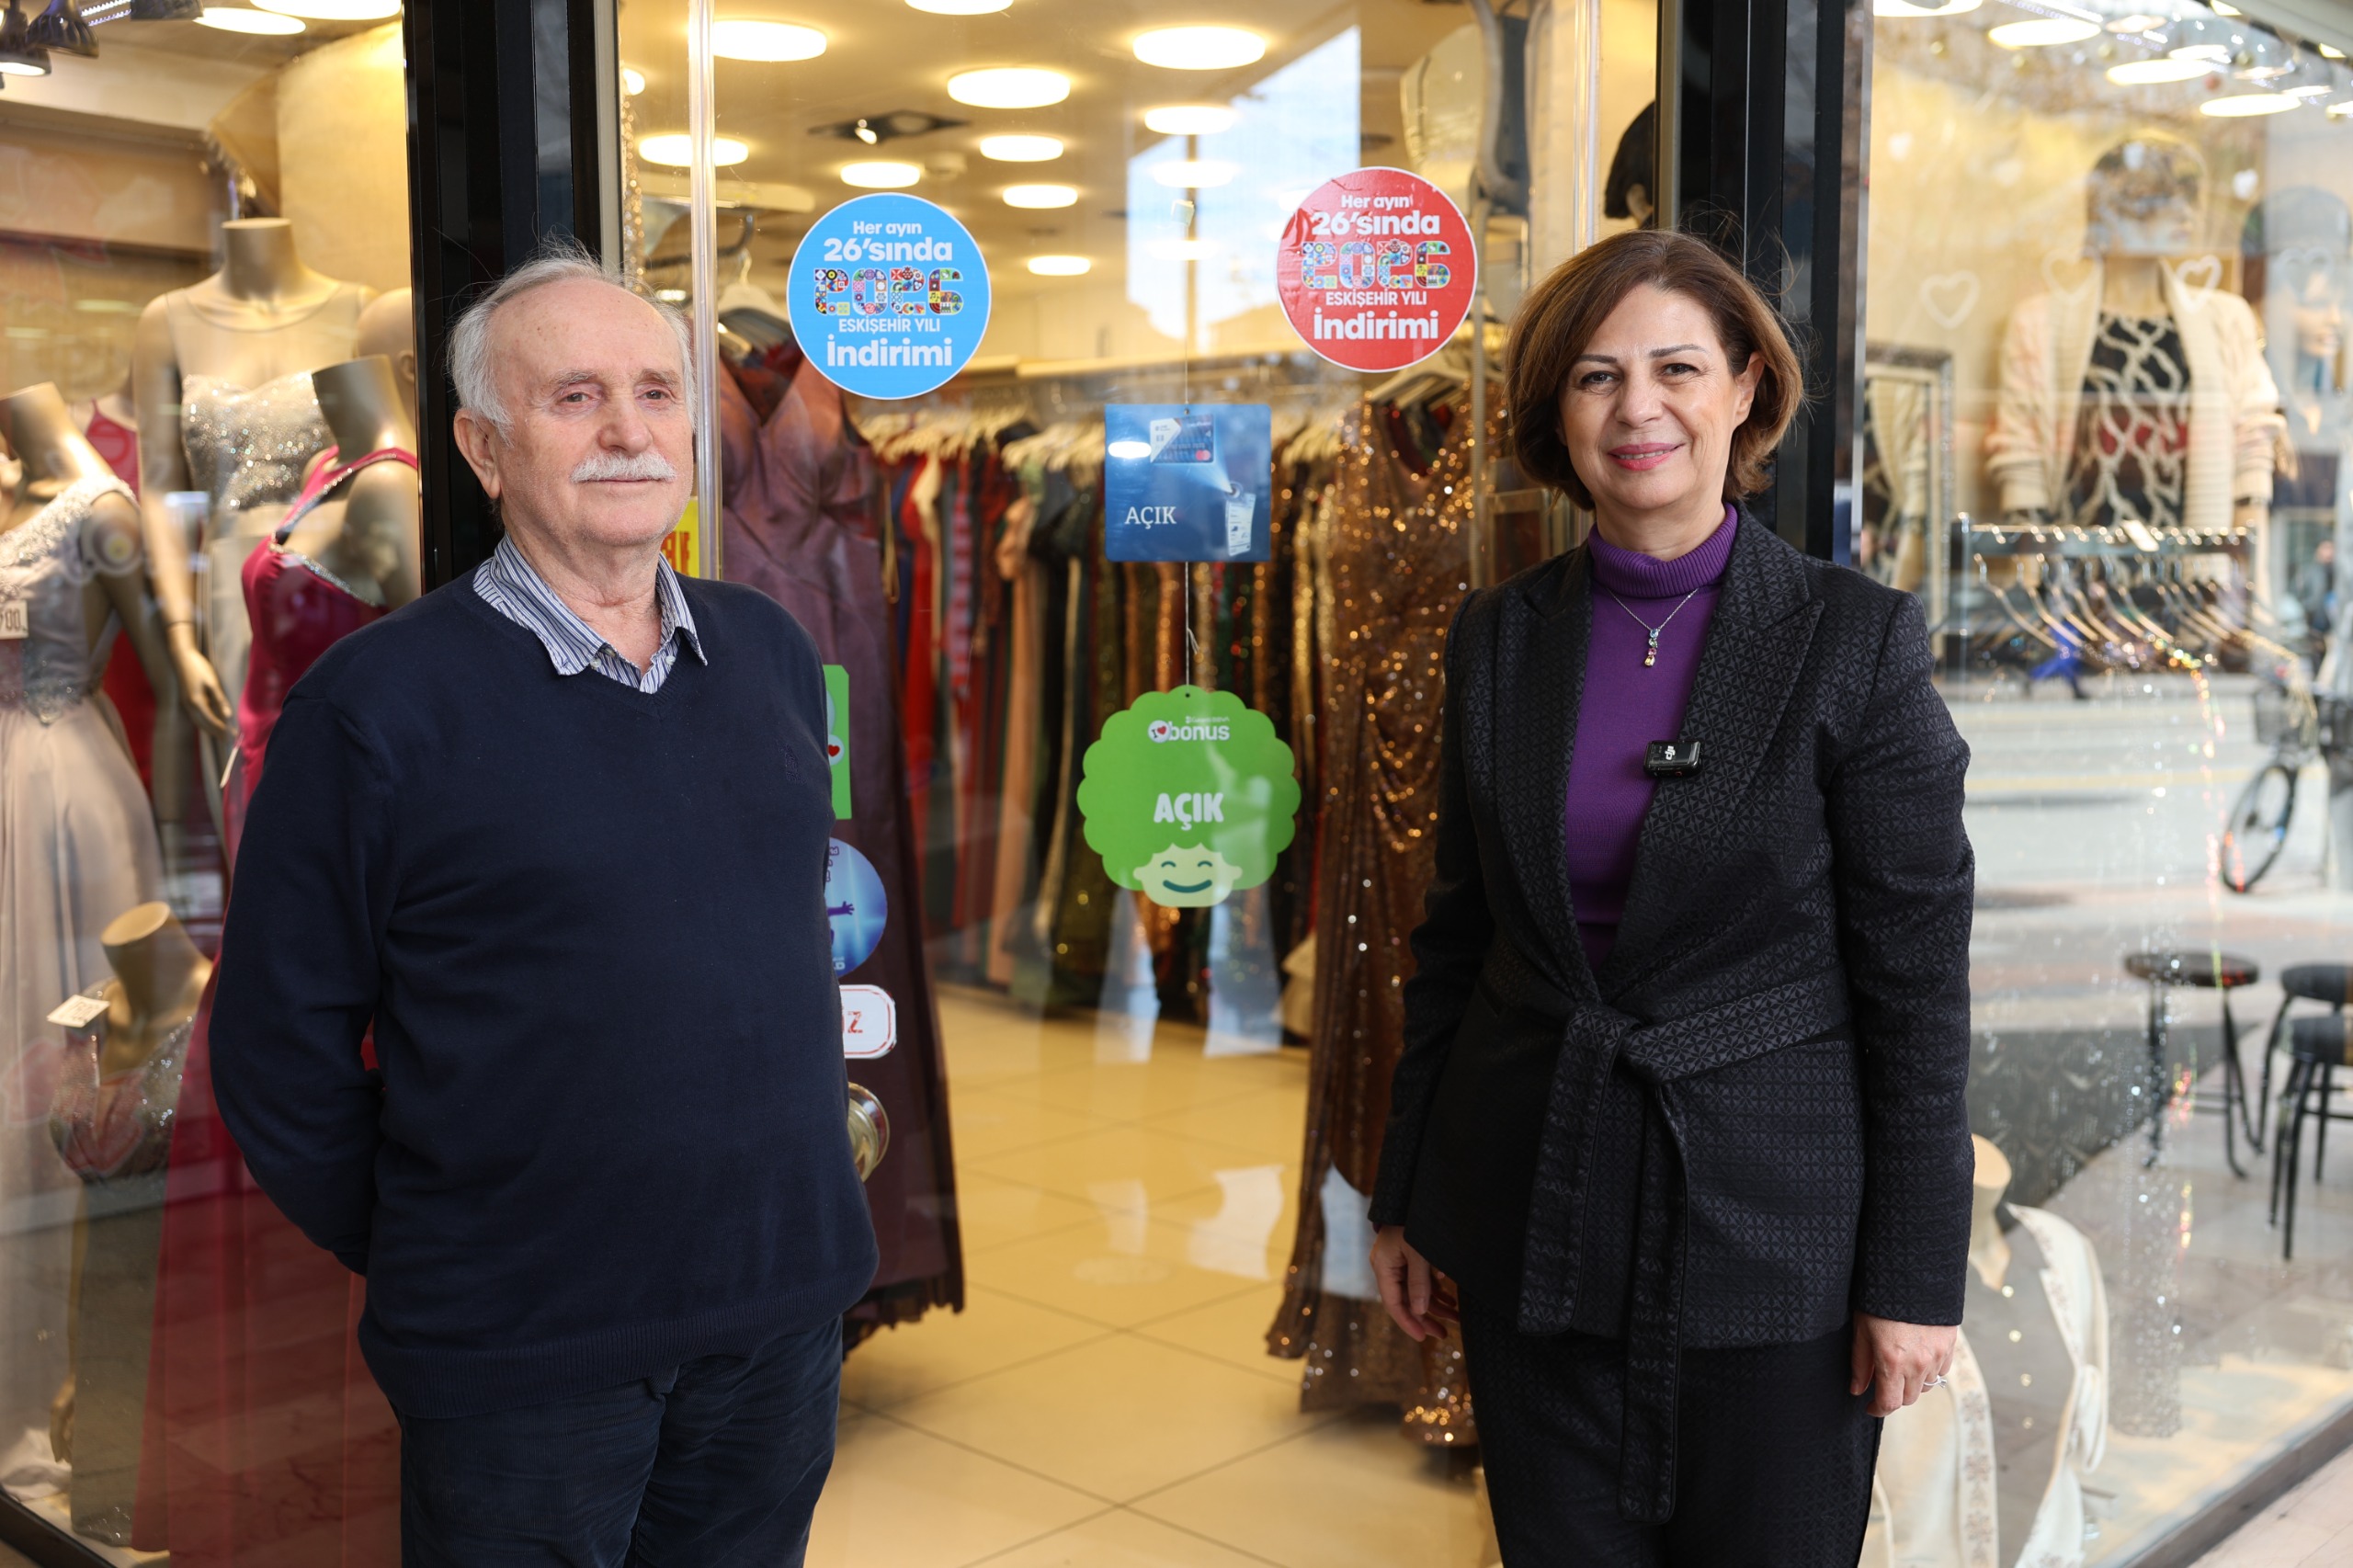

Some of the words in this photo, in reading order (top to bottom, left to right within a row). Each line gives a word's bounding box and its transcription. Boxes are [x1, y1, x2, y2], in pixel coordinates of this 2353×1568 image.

[1341, 195, 1370, 208] Her
[1373, 196, 1410, 210] ayın
[853, 221, 882, 234] Her
[886, 222, 922, 237] ayın
[1302, 239, 1450, 289] 2026
[814, 267, 963, 315] 2026
[1325, 289, 1398, 308] ESKİŞEHİR
[1402, 291, 1427, 305] YILI
[838, 315, 911, 335] ESKİŞEHİR
[915, 318, 940, 332] YILI
[1313, 307, 1439, 339] İndirimi
[827, 334, 952, 366] İndirimi
[1124, 506, 1177, 529] AÇIK
[1167, 721, 1231, 741] bonus
[1154, 792, 1224, 831] AÇIK
